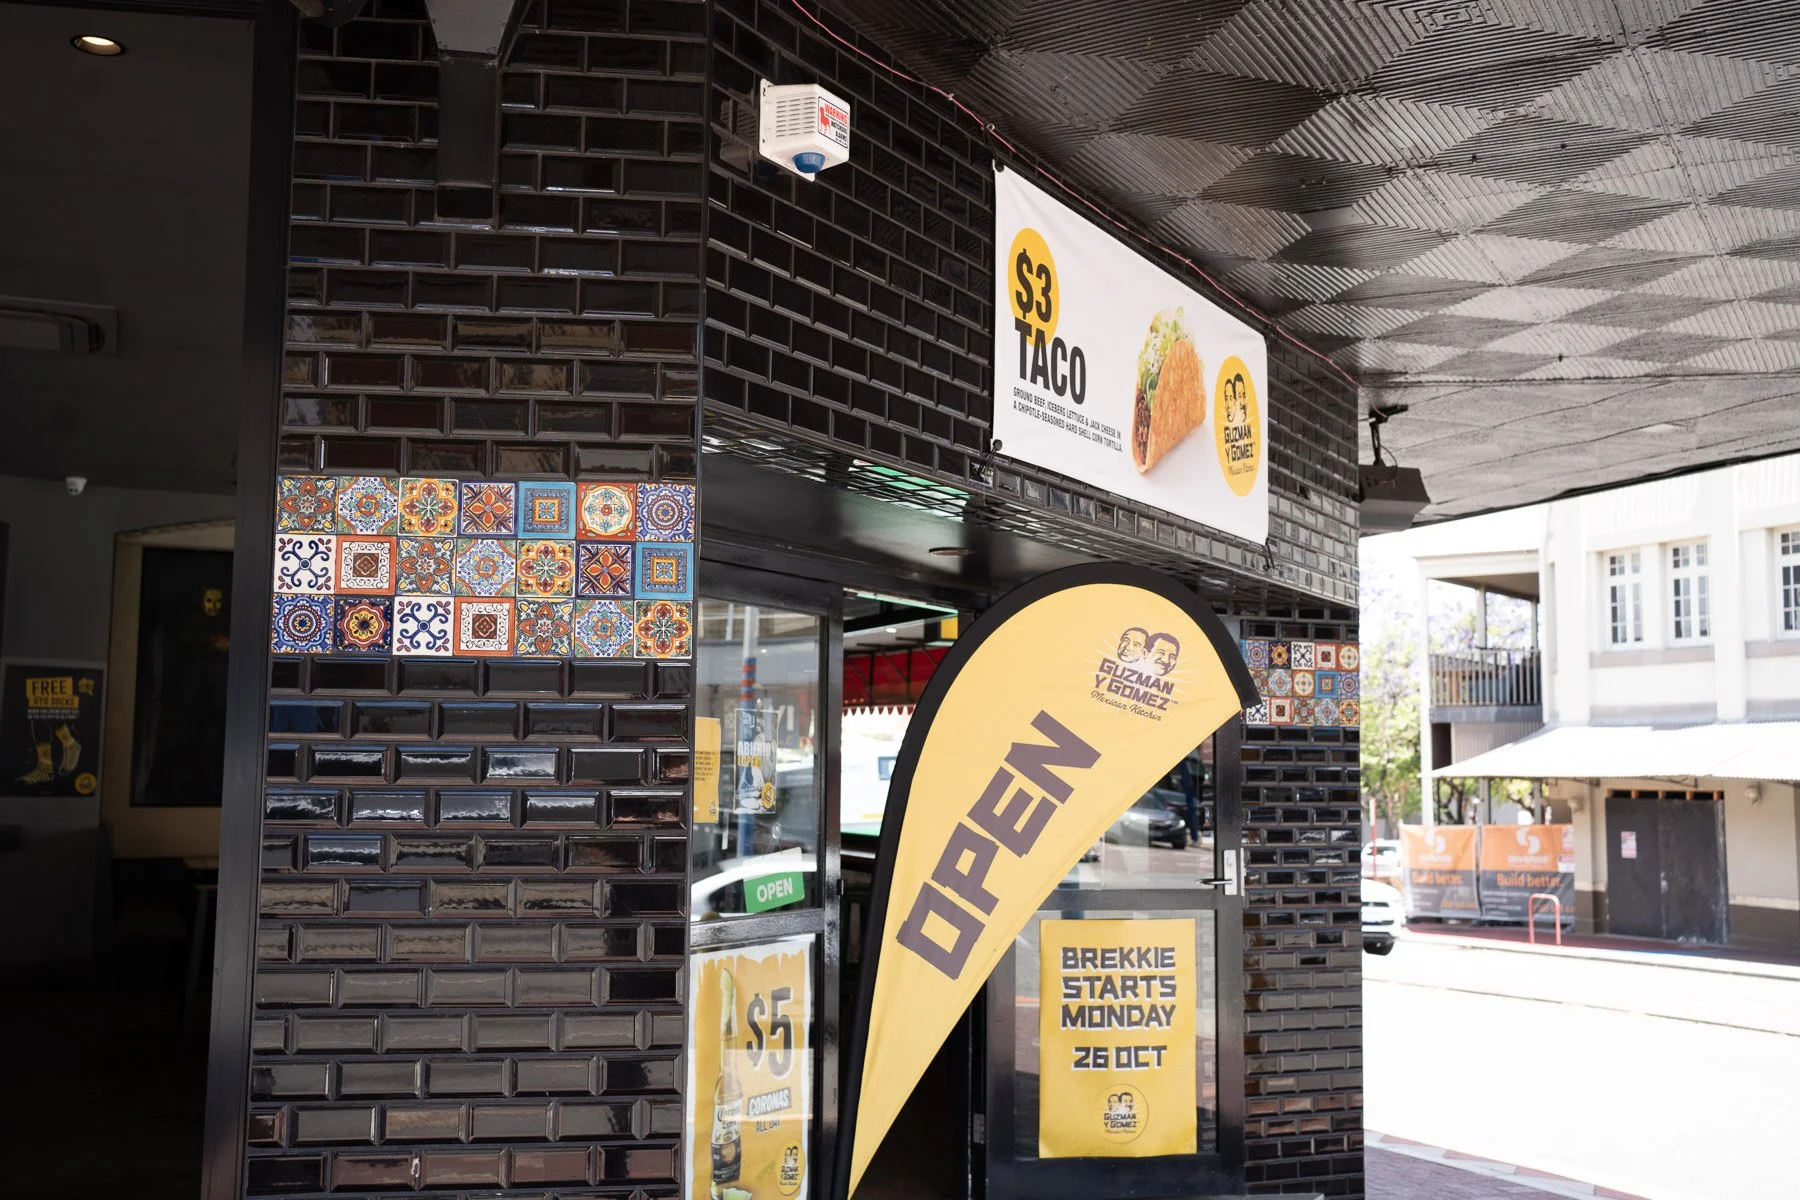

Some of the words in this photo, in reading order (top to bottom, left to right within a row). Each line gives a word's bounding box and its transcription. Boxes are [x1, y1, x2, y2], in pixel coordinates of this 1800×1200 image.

[1016, 248, 1051, 323] $3
[1015, 316, 1086, 405] TACO
[1014, 387, 1033, 403] GROUND
[1034, 395, 1047, 410] BEEF,
[1047, 401, 1066, 417] ICEBERG
[1066, 408, 1085, 425] LETTUCE
[1090, 419, 1101, 431] JACK
[1101, 424, 1116, 438] CHEESE
[1018, 402, 1065, 429] CHIPOTLE-SEASONED
[1065, 421, 1078, 435] HARD
[1078, 427, 1091, 440] SHELL
[1091, 432, 1103, 445] CORN
[1224, 425, 1252, 444] GUZMAN
[1225, 447, 1230, 464] Y
[1231, 443, 1254, 462] GOMEZ
[32, 679, 67, 696] FREE
[1098, 657, 1175, 696] GUZMAN
[1090, 690, 1128, 710] Mexican
[1129, 703, 1162, 721] Kitchen
[1095, 674, 1107, 689] Y
[1106, 677, 1171, 712] GOMEZ
[895, 709, 1102, 981] OPEN
[756, 877, 794, 903] OPEN
[1496, 873, 1524, 887] Build
[1061, 946, 1176, 972] BREKKIE
[1062, 974, 1177, 1001] STARTS
[1061, 1003, 1176, 1030] MONDAY
[746, 986, 795, 1079] $5
[1072, 1046, 1109, 1070] 26
[1114, 1045, 1167, 1070] OCT
[749, 1088, 789, 1116] CORONAS
[756, 1120, 768, 1134] ALL
[1103, 1112, 1137, 1121] GUZMAN
[1110, 1120, 1137, 1128] GOMEZ
